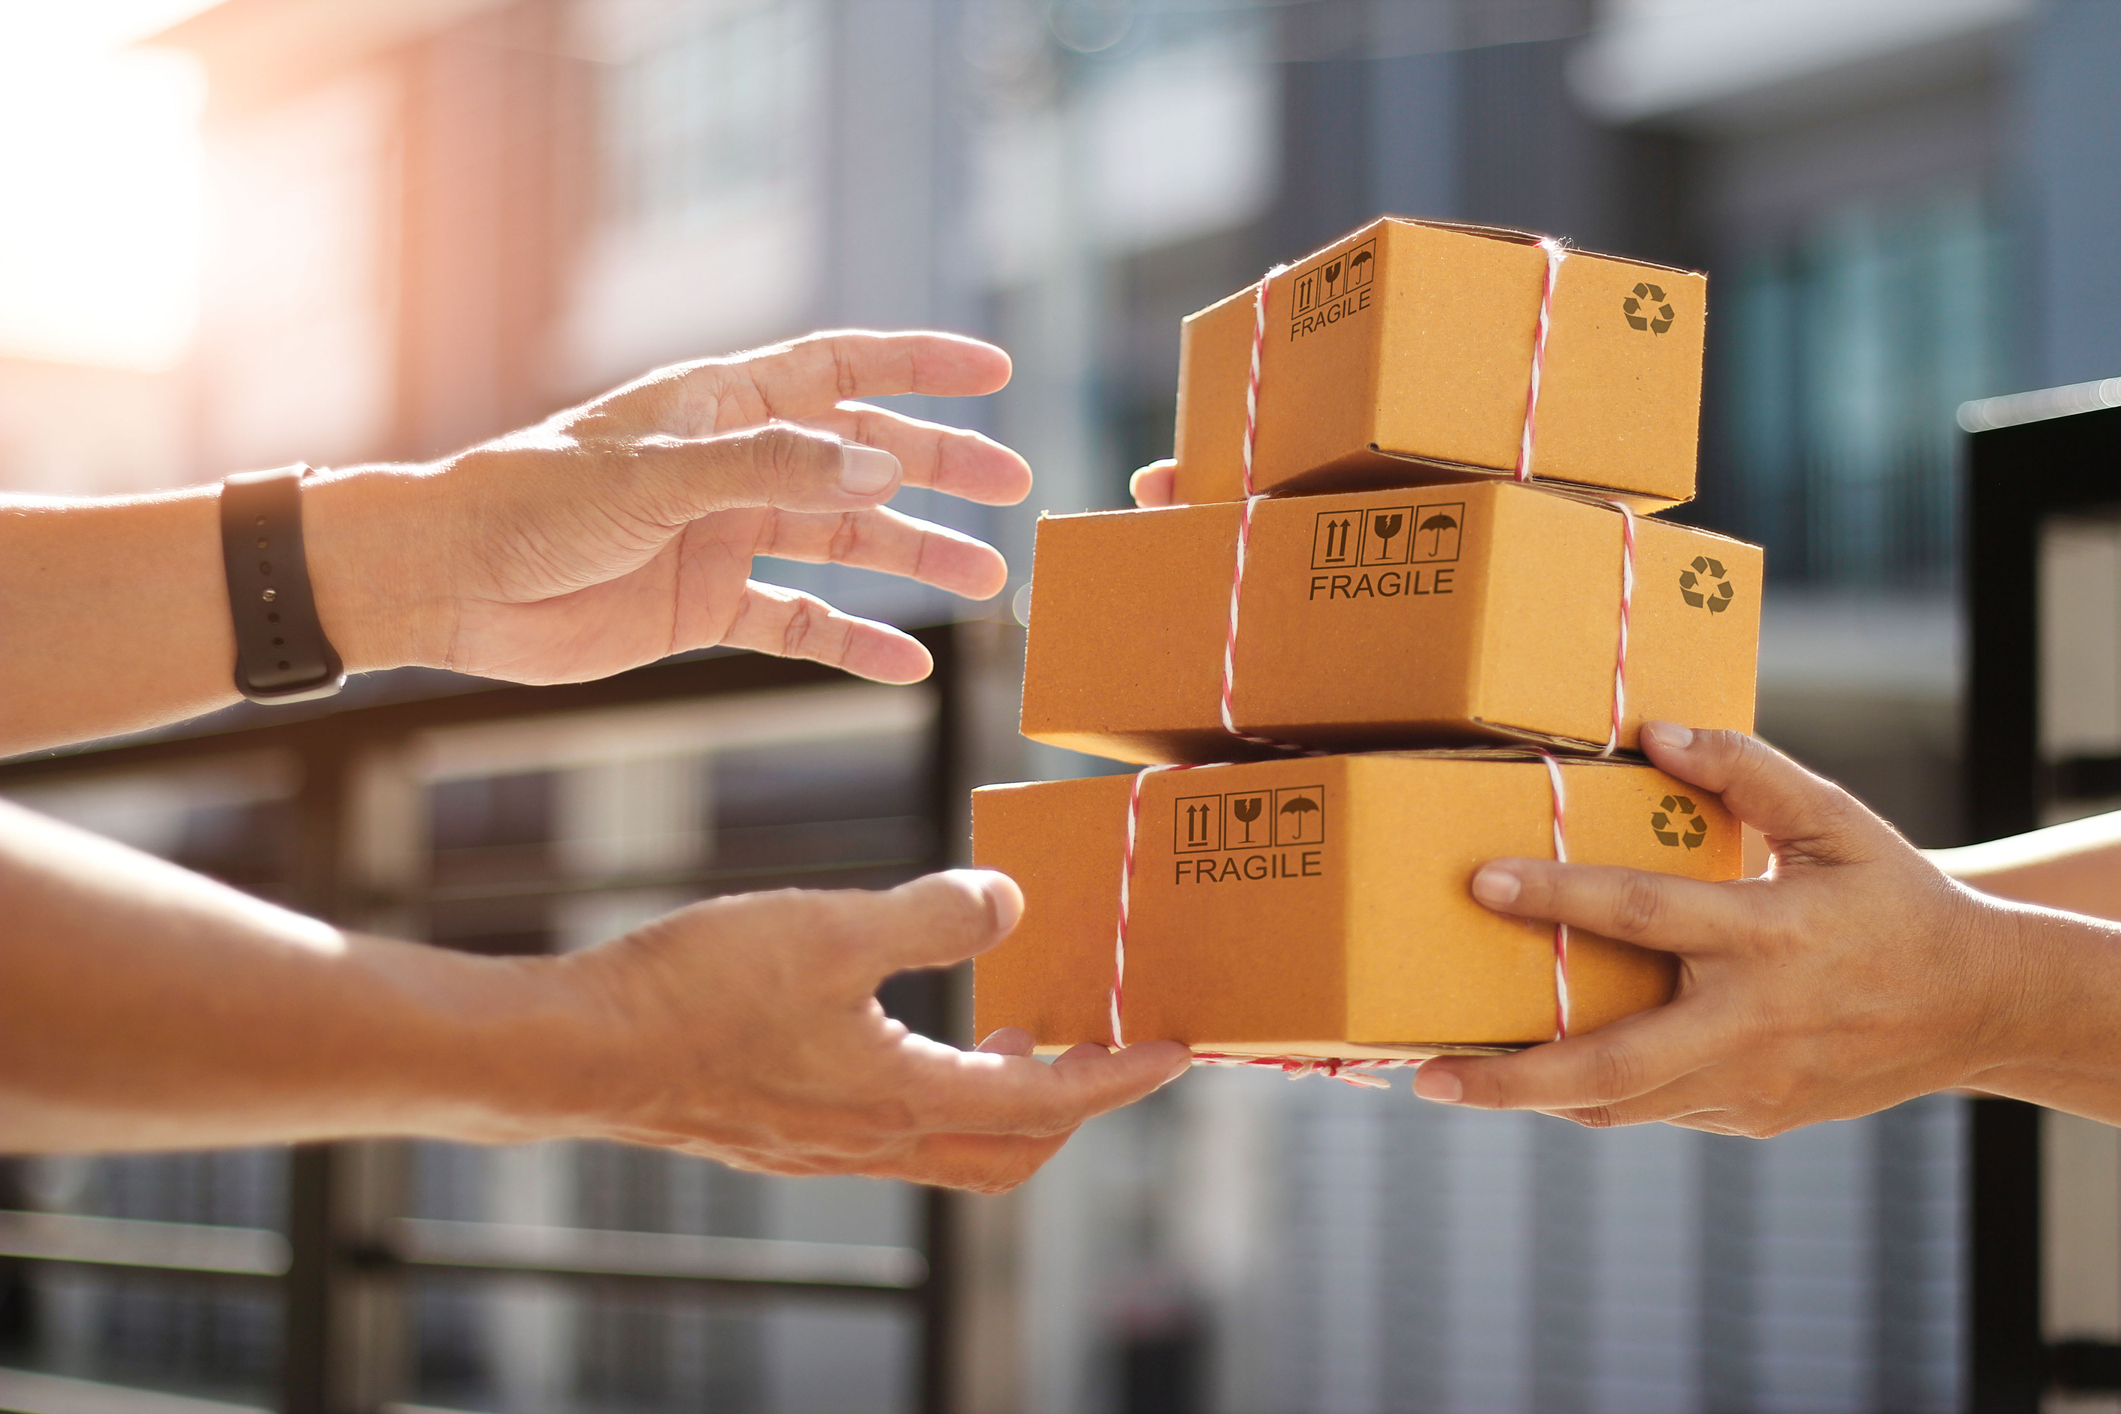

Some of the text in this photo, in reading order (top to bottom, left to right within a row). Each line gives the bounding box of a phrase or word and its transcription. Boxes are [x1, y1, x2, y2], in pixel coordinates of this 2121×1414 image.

[1291, 288, 1371, 342] FRAGILE
[1309, 569, 1455, 600] FRAGILE
[1175, 851, 1322, 885] FRAGILE
